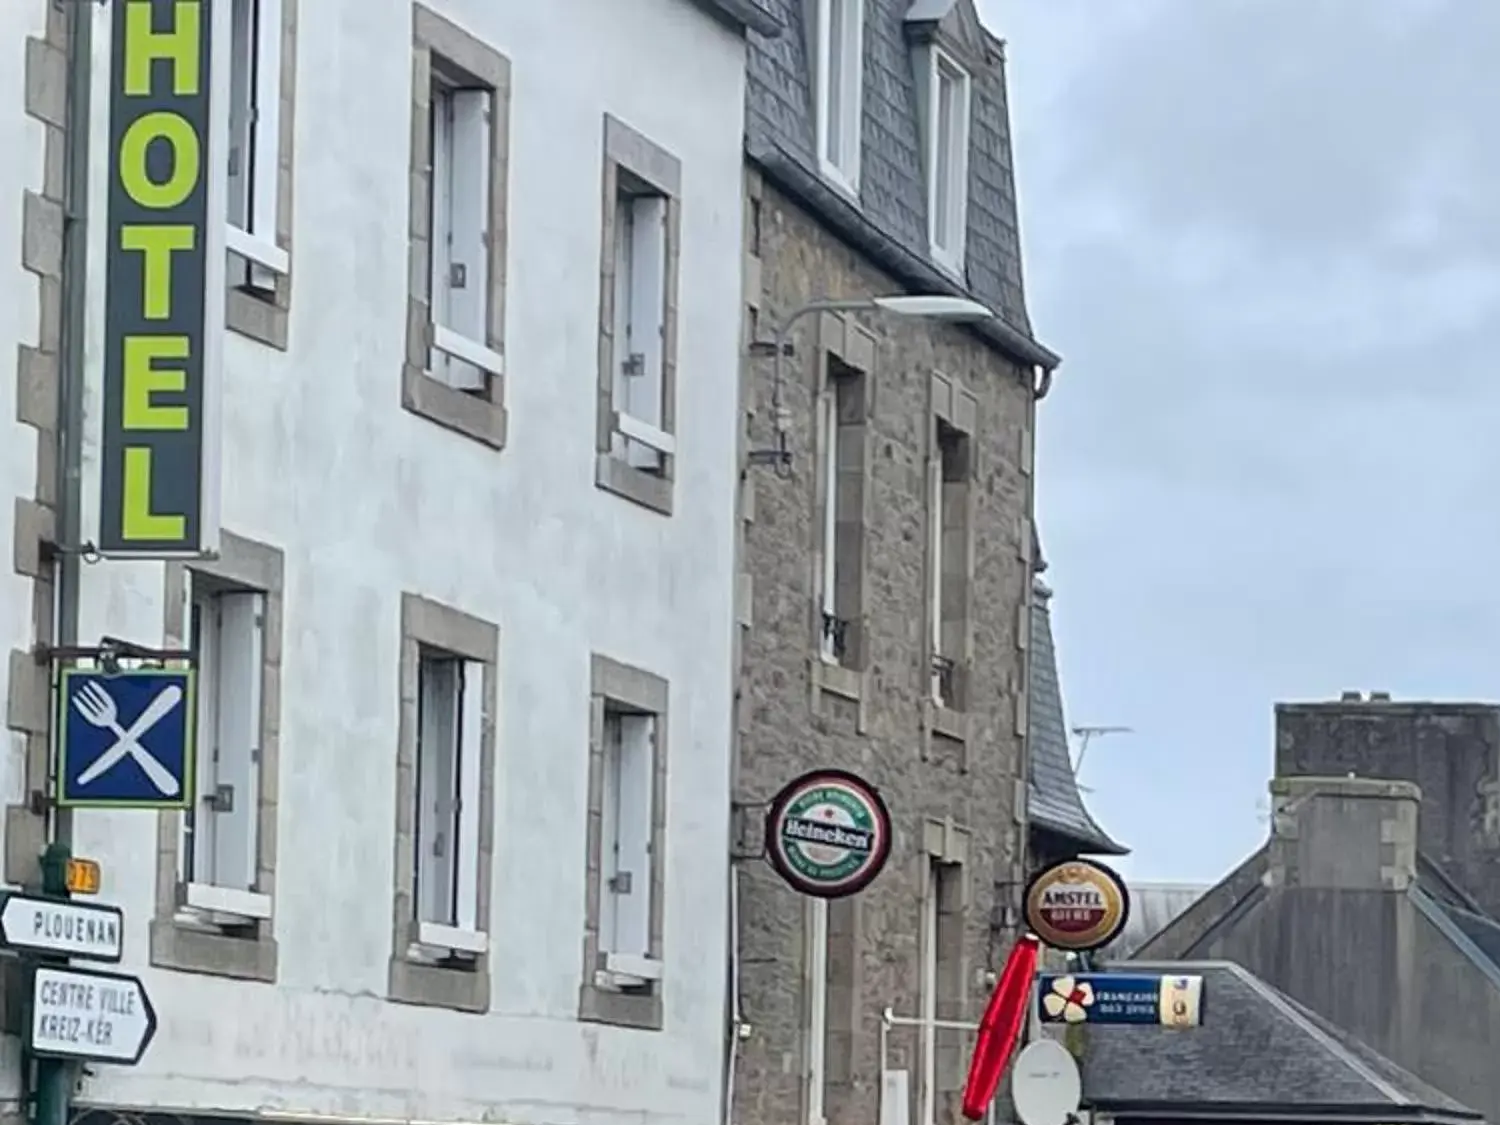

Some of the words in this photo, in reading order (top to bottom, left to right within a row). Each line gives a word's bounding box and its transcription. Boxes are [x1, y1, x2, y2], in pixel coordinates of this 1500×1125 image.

[118, 1, 201, 540] HOTEL
[786, 820, 868, 848] Heineken
[1043, 891, 1102, 905] AMSTEL
[34, 911, 117, 945] PLOUENAN
[41, 980, 94, 1010] CENTRE
[99, 987, 136, 1015] VILLE
